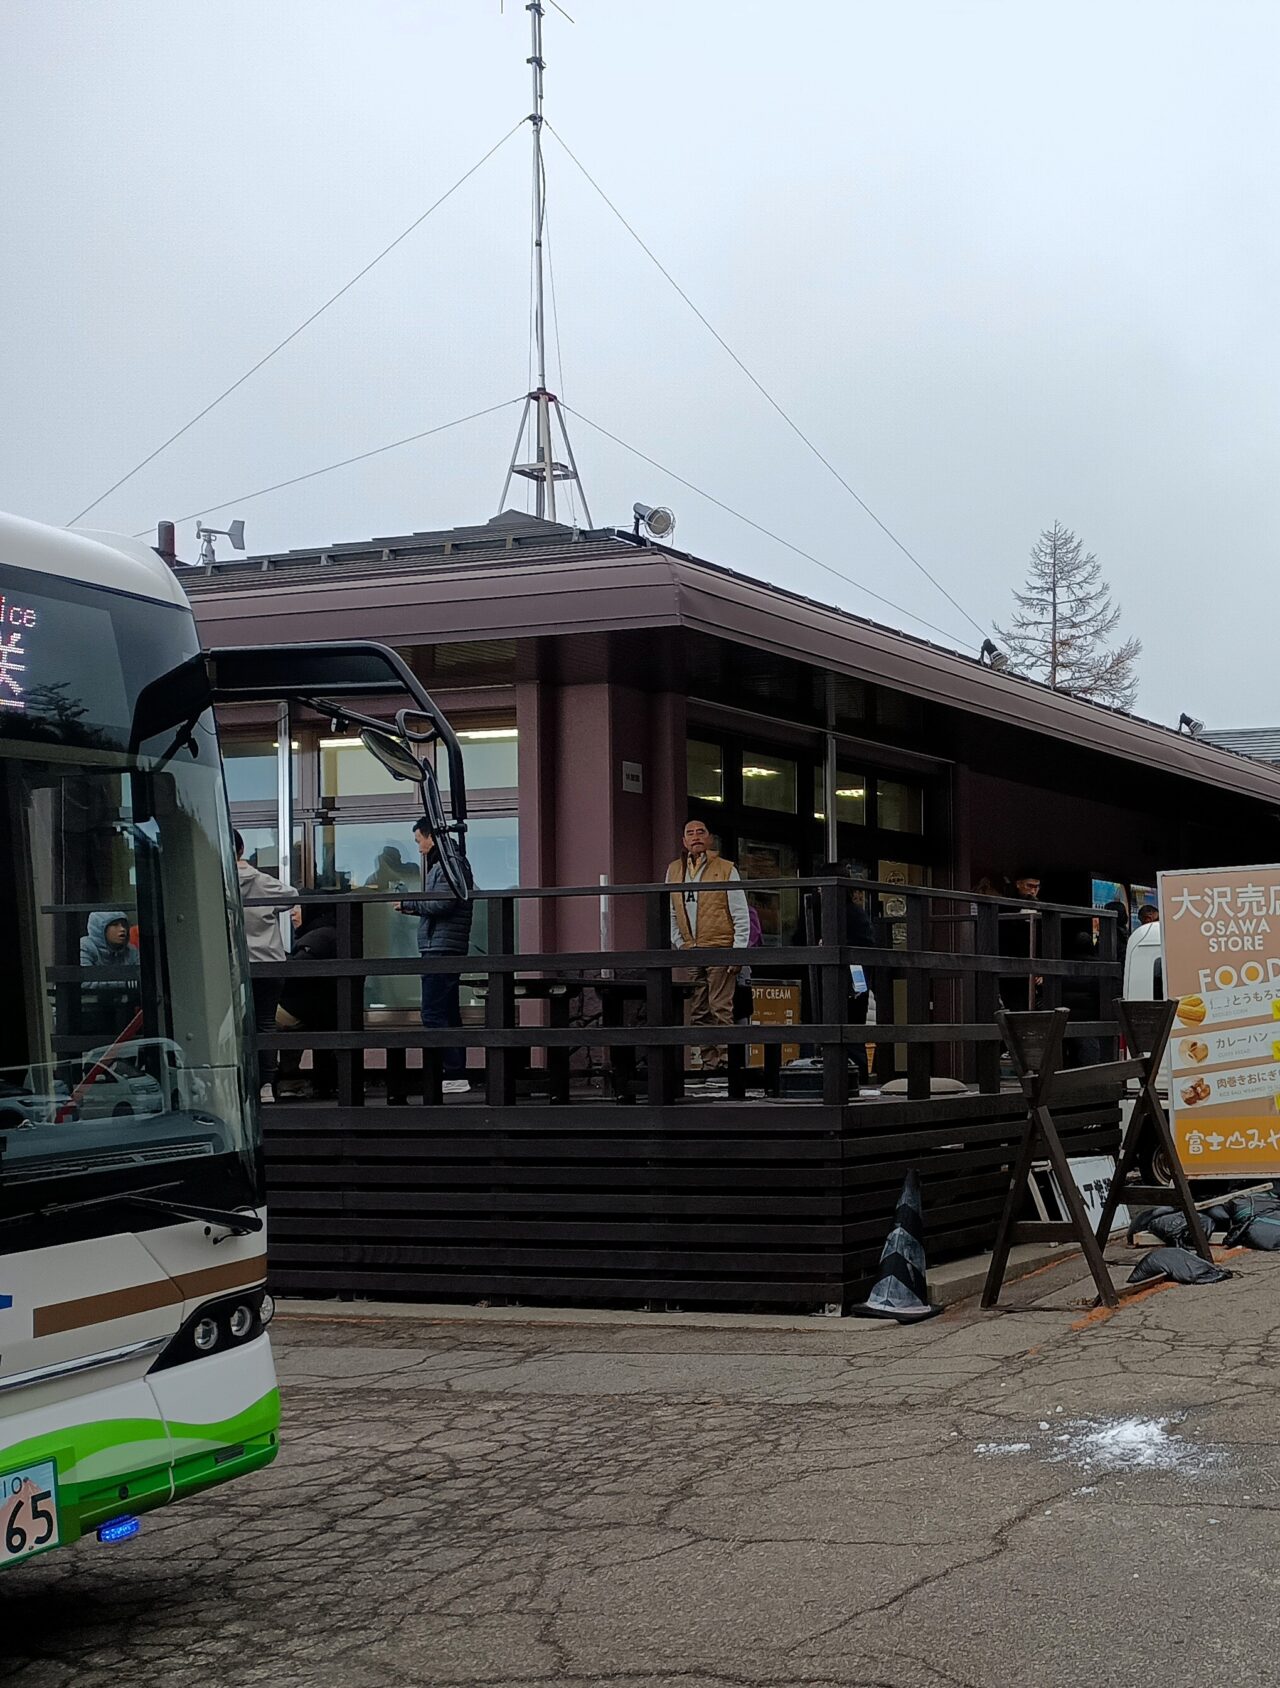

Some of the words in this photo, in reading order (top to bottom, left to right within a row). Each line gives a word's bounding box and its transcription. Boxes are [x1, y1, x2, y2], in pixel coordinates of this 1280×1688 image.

[1201, 918, 1271, 936] OSAWA
[1209, 936, 1264, 953] STORE
[765, 988, 792, 1000] CREAM
[6, 1490, 54, 1553] 65
